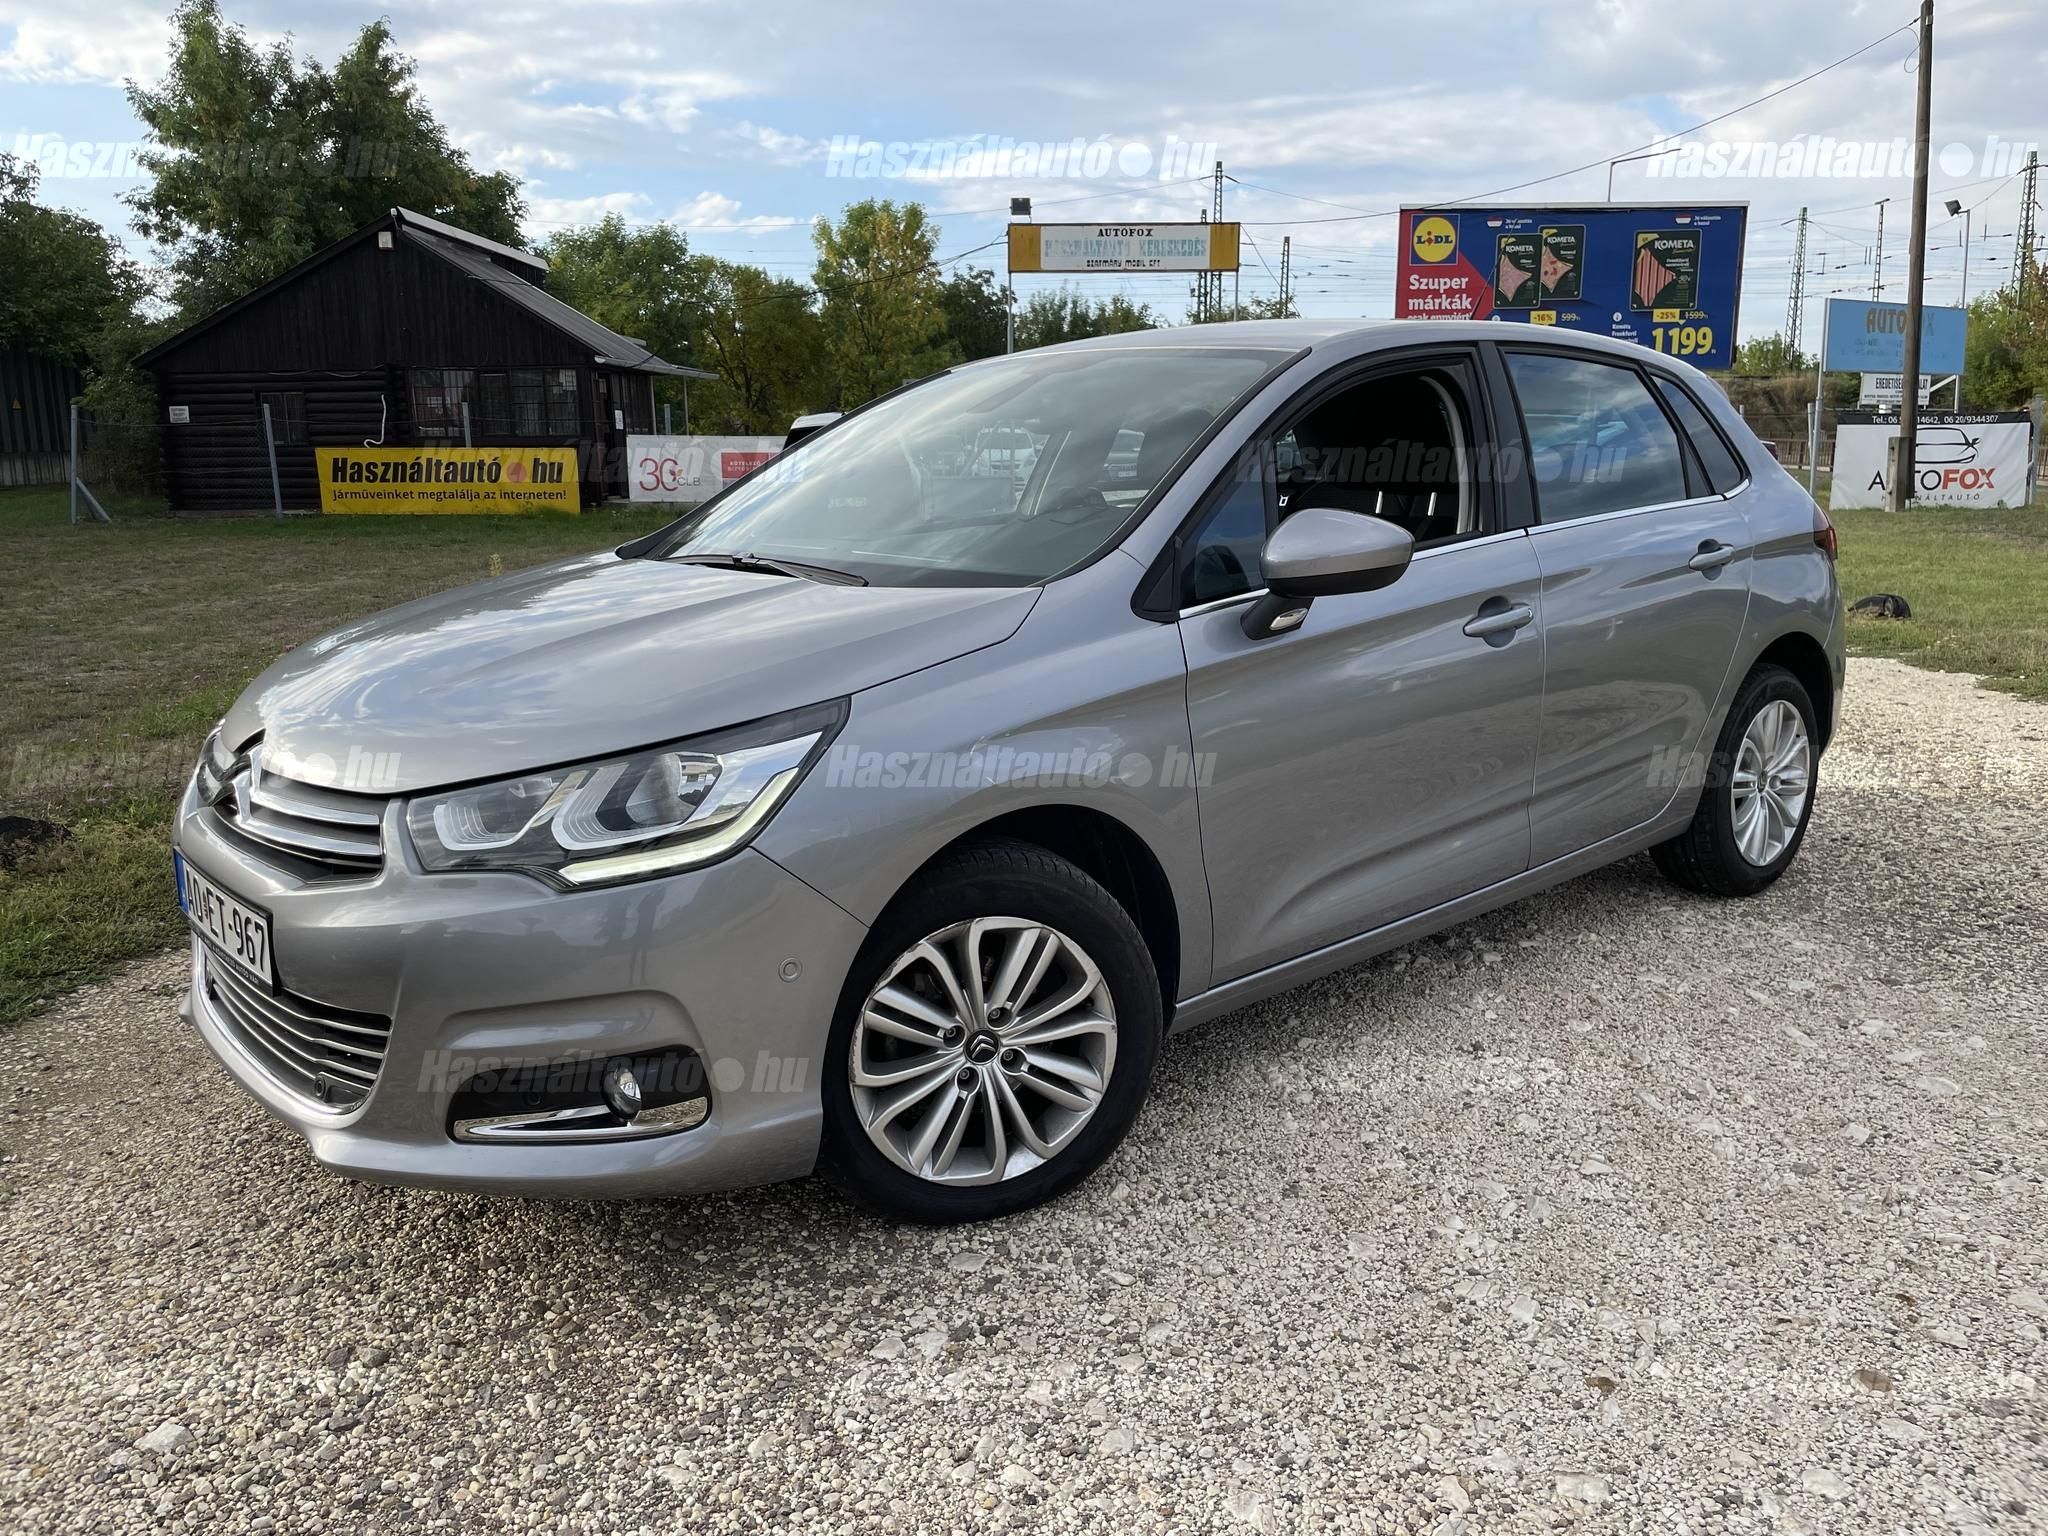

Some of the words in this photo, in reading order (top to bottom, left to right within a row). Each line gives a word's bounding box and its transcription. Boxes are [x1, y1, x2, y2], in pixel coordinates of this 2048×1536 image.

[1547, 236, 1576, 244] KOMETA
[1654, 239, 1694, 250] KOMETA
[1505, 245, 1534, 253] KOMETA
[1409, 274, 1469, 293] Szuper
[1408, 294, 1472, 310] márkák
[1534, 313, 1553, 321] -16%
[1561, 313, 1577, 321] 599
[1656, 311, 1676, 320] -25%
[1866, 307, 1935, 336] AUTOX
[1888, 415, 1898, 424] 06
[1944, 415, 1954, 424] 06
[331, 456, 502, 483] Használtautó
[532, 457, 563, 484] hu
[677, 477, 701, 486] CLB
[418, 489, 480, 502] megtalálja
[483, 492, 497, 500] az
[499, 489, 567, 501] interneten!
[206, 886, 265, 972] ET-967
